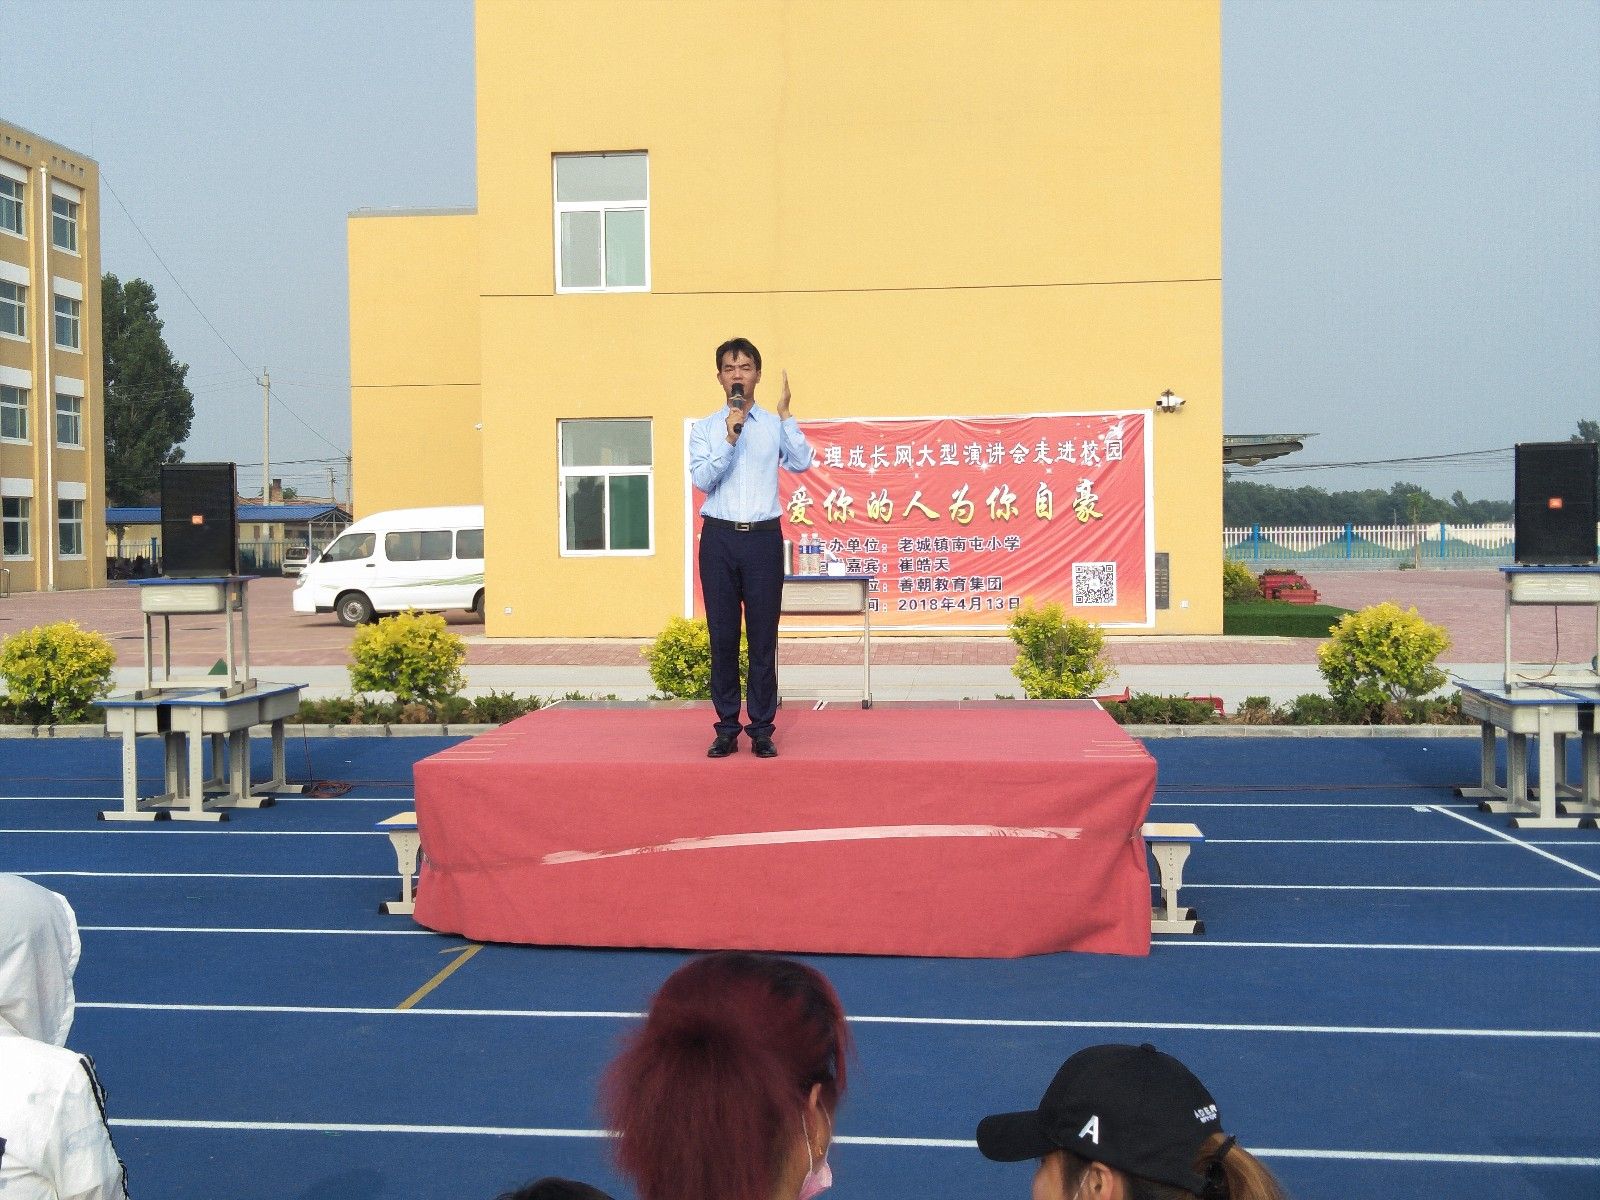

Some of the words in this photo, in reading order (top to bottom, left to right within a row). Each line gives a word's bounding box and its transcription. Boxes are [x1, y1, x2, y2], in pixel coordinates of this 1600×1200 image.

[787, 479, 1103, 526] 爱你的人为你自豪
[820, 557, 950, 574] 嘉宾：崔皓天
[1078, 1114, 1099, 1145] A
